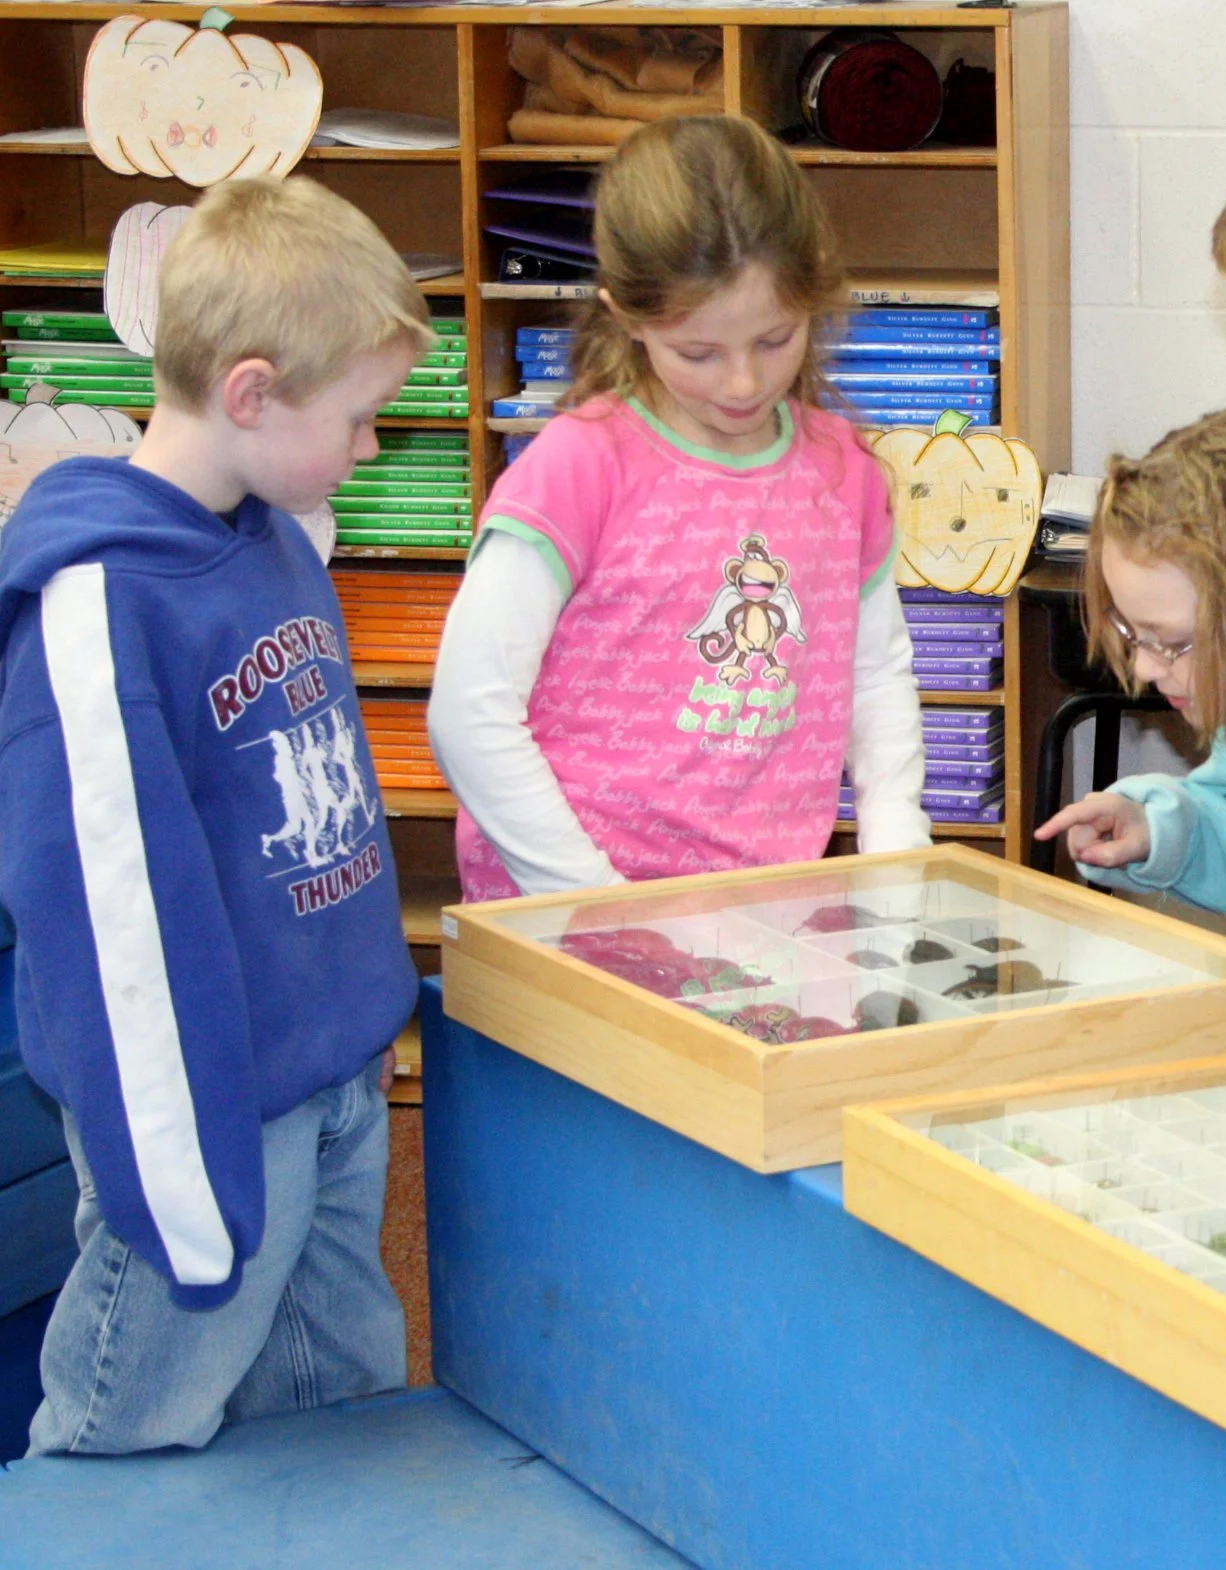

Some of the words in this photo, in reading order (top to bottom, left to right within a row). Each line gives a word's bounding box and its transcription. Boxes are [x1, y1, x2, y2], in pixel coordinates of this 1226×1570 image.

[851, 291, 892, 302] BLUE
[207, 615, 343, 731] ROOSEVELT
[282, 664, 328, 717] BLUE
[289, 841, 382, 916] THUNDER
